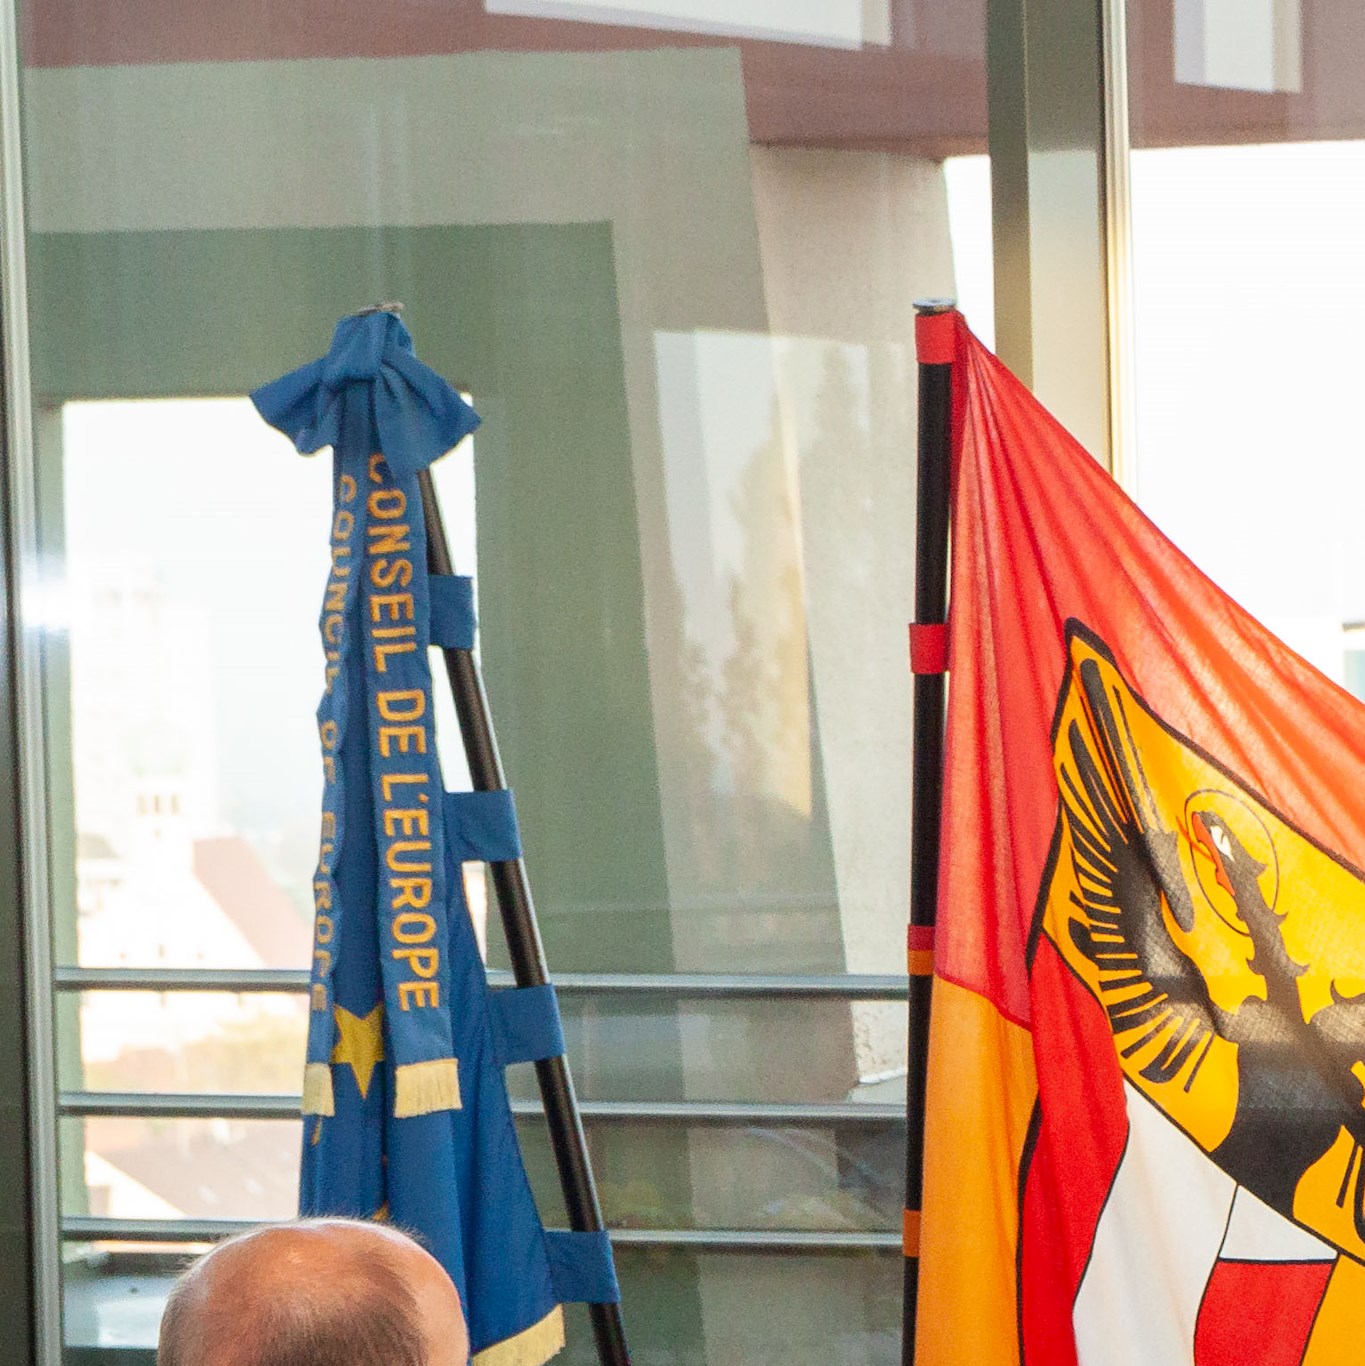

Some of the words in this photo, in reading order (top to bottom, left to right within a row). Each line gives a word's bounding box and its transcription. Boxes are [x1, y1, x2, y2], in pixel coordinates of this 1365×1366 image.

[367, 453, 417, 673] CONSEIL
[376, 689, 427, 758] DE
[380, 773, 440, 1012] L'EUROPE
